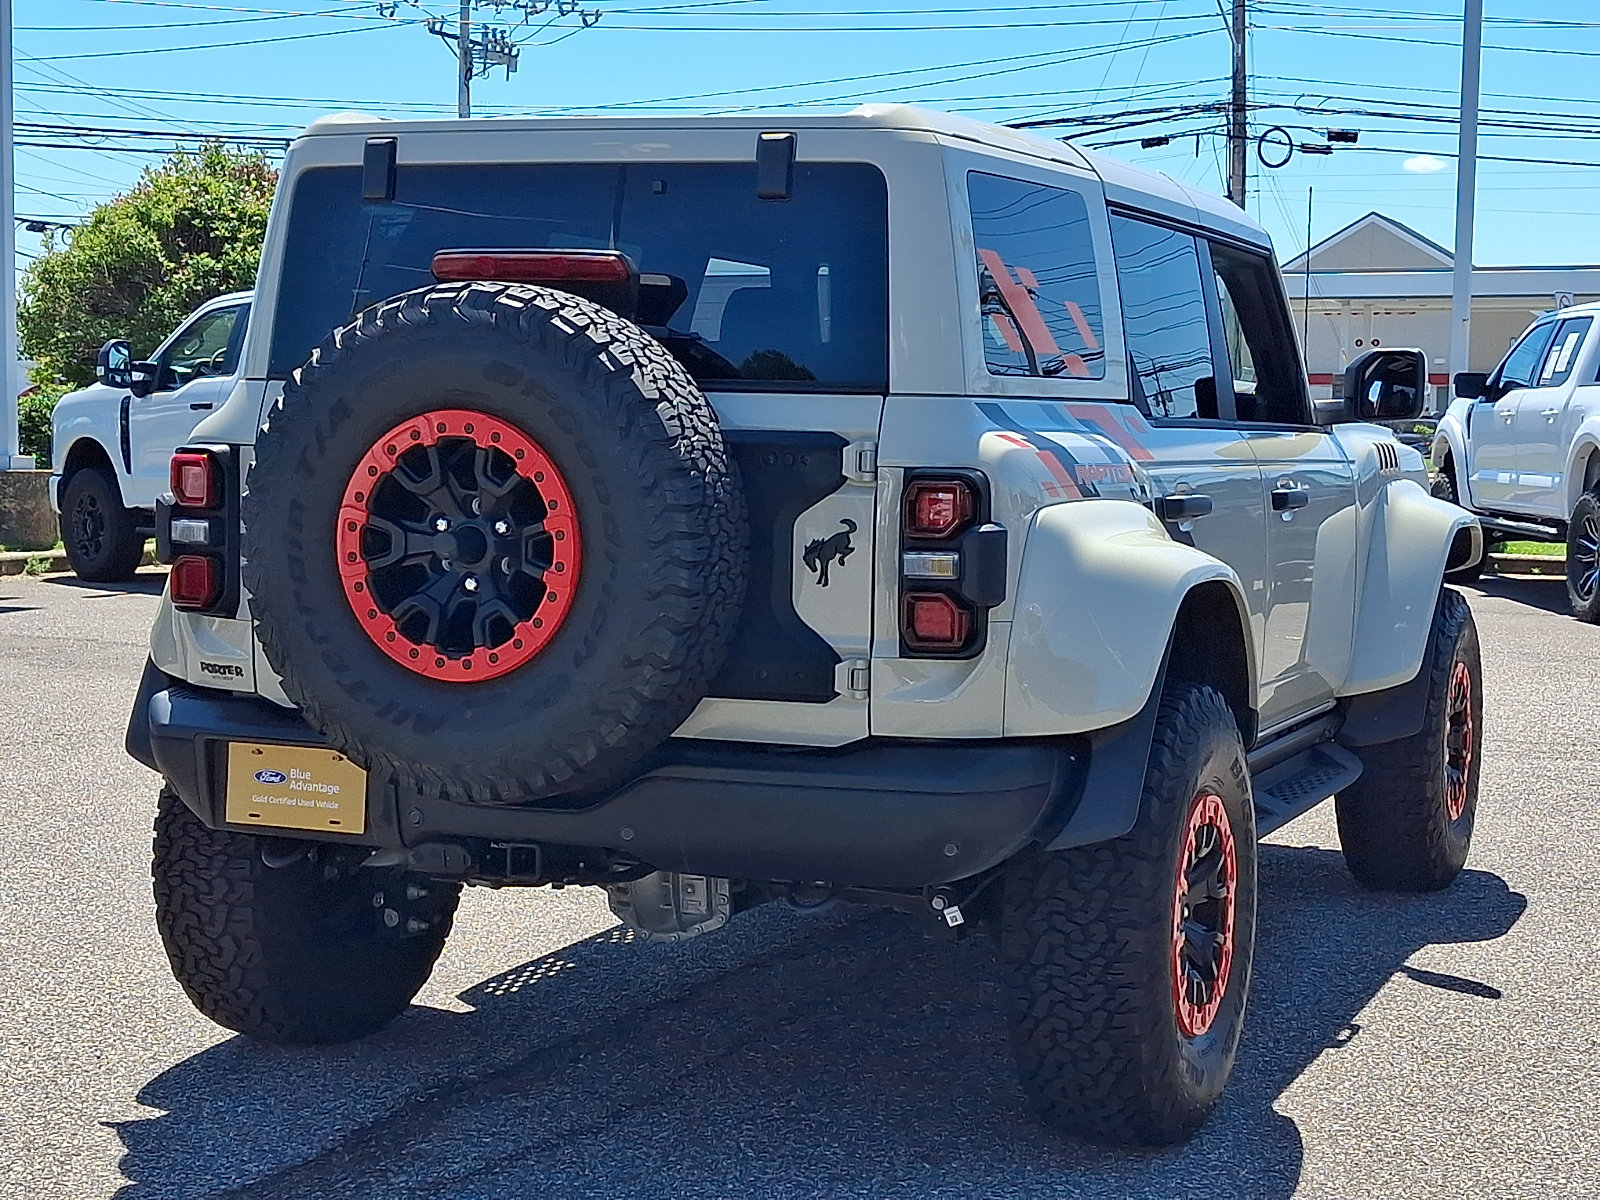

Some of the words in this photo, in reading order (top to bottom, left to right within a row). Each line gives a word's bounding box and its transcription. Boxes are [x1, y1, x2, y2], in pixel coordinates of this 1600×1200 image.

[200, 661, 245, 677] PORTER
[259, 771, 282, 783] Ford
[290, 769, 311, 780] Blue
[289, 780, 340, 795] Advantage
[252, 795, 268, 803] Gold
[268, 796, 297, 806] Certified
[298, 799, 315, 807] Used
[315, 800, 339, 809] Vehicle
